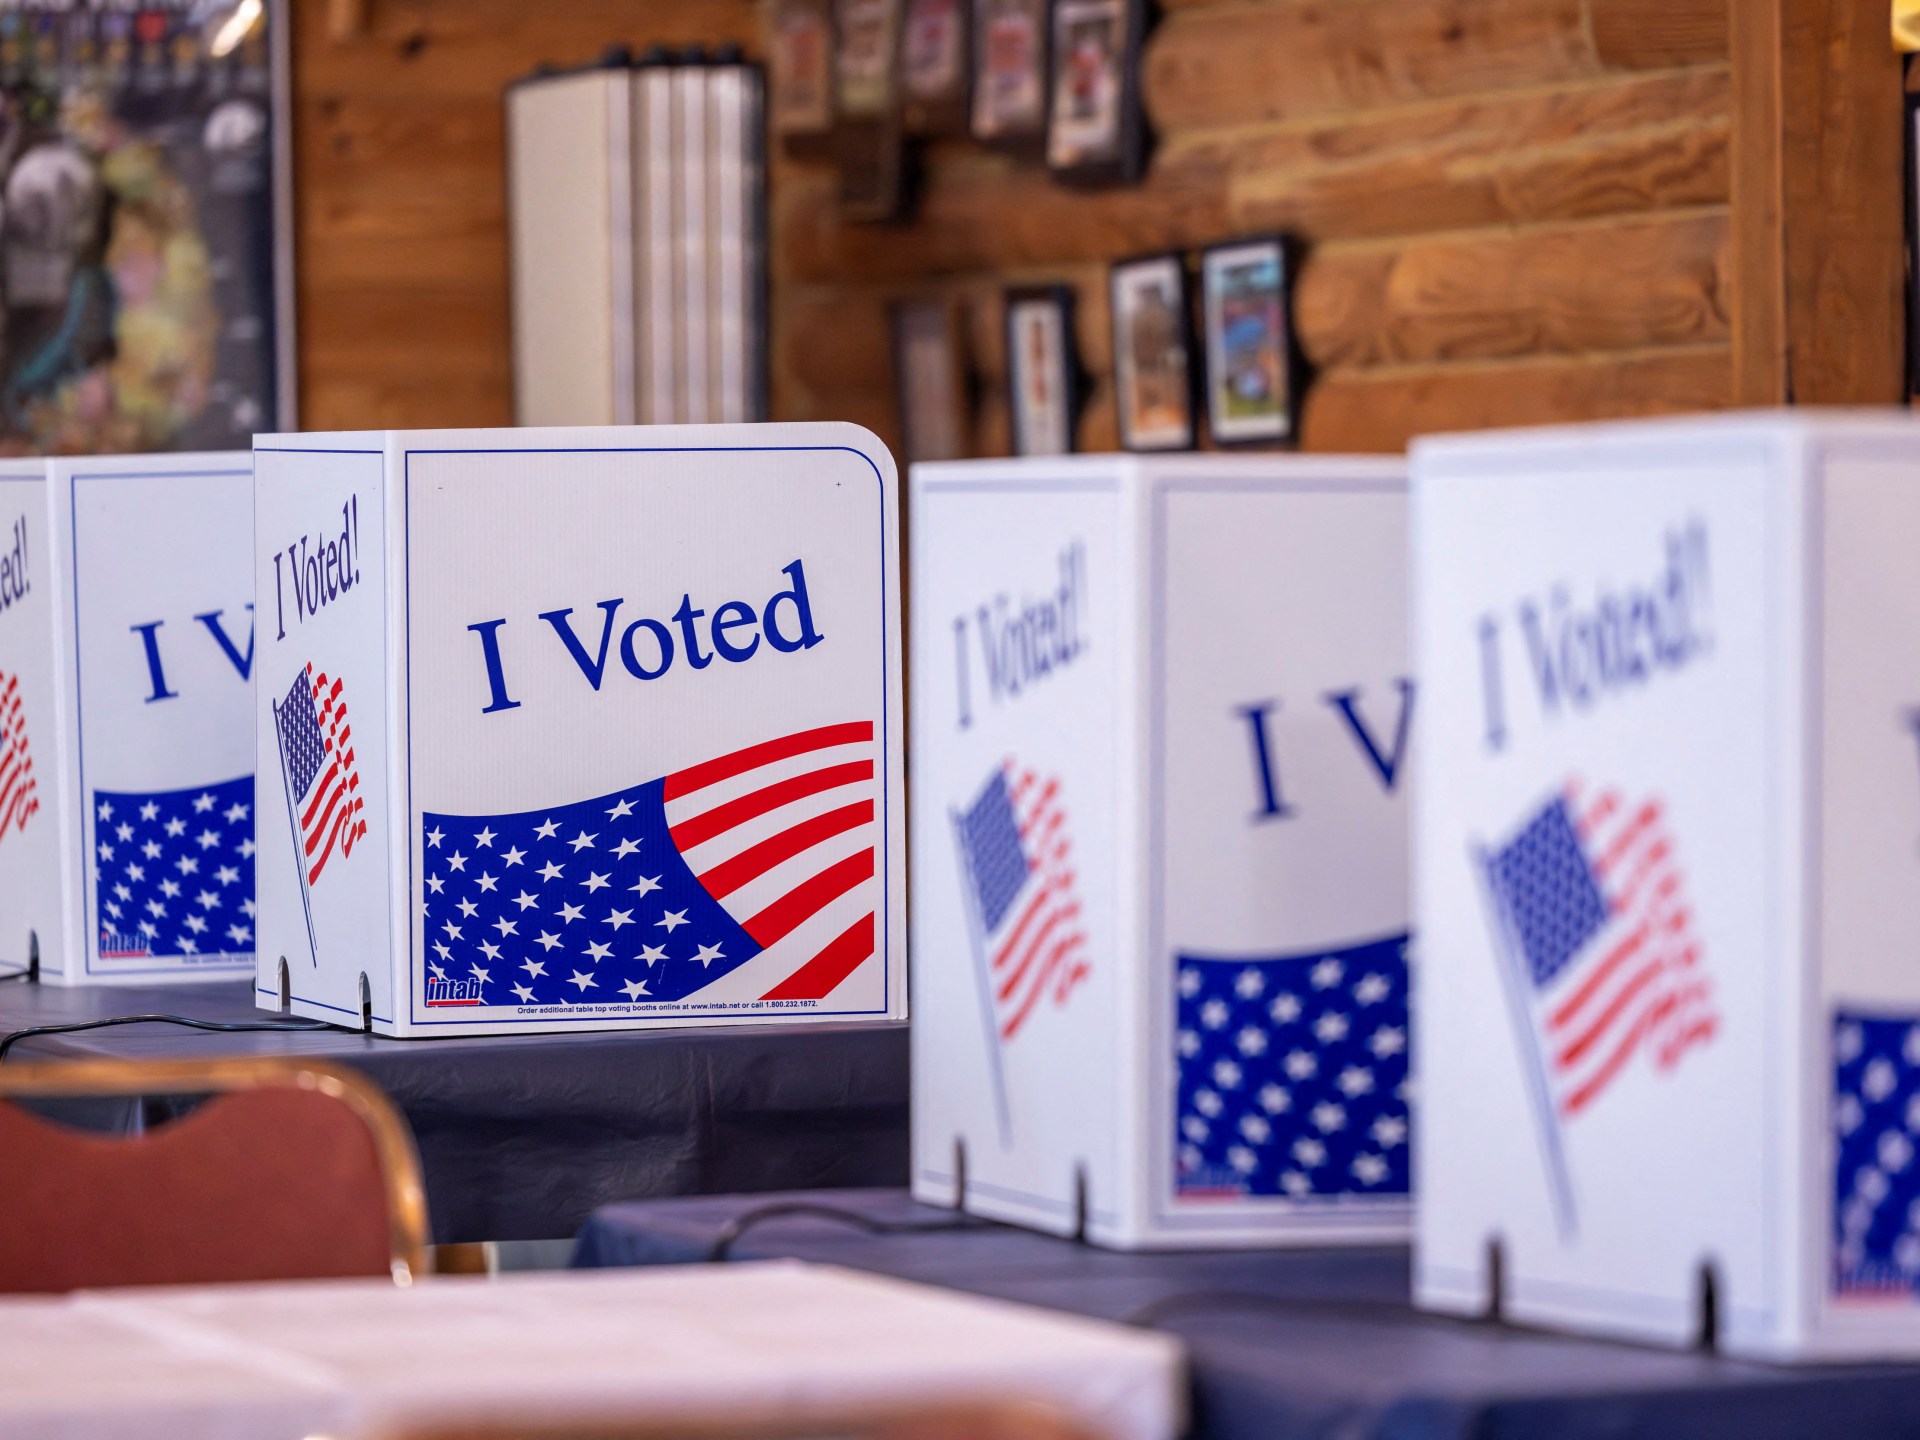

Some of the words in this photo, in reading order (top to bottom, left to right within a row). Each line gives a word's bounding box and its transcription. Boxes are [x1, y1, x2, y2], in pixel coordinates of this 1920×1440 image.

[0, 512, 31, 614] ed!
[274, 552, 286, 642] I
[288, 493, 360, 625] Voted!
[129, 619, 180, 705] I
[467, 618, 522, 714] I
[538, 558, 825, 692] Voted
[1231, 697, 1298, 827] I
[426, 976, 482, 1001] intab
[517, 1006, 538, 1015] Order
[539, 1006, 575, 1014] additional
[576, 1005, 594, 1013] table
[595, 1005, 607, 1014] top
[608, 1005, 631, 1013] voting
[632, 1004, 657, 1012] booths
[658, 1003, 681, 1011] online
[690, 1002, 741, 1010] www.intab.net
[765, 1000, 818, 1009] 1.800.232.1872.
